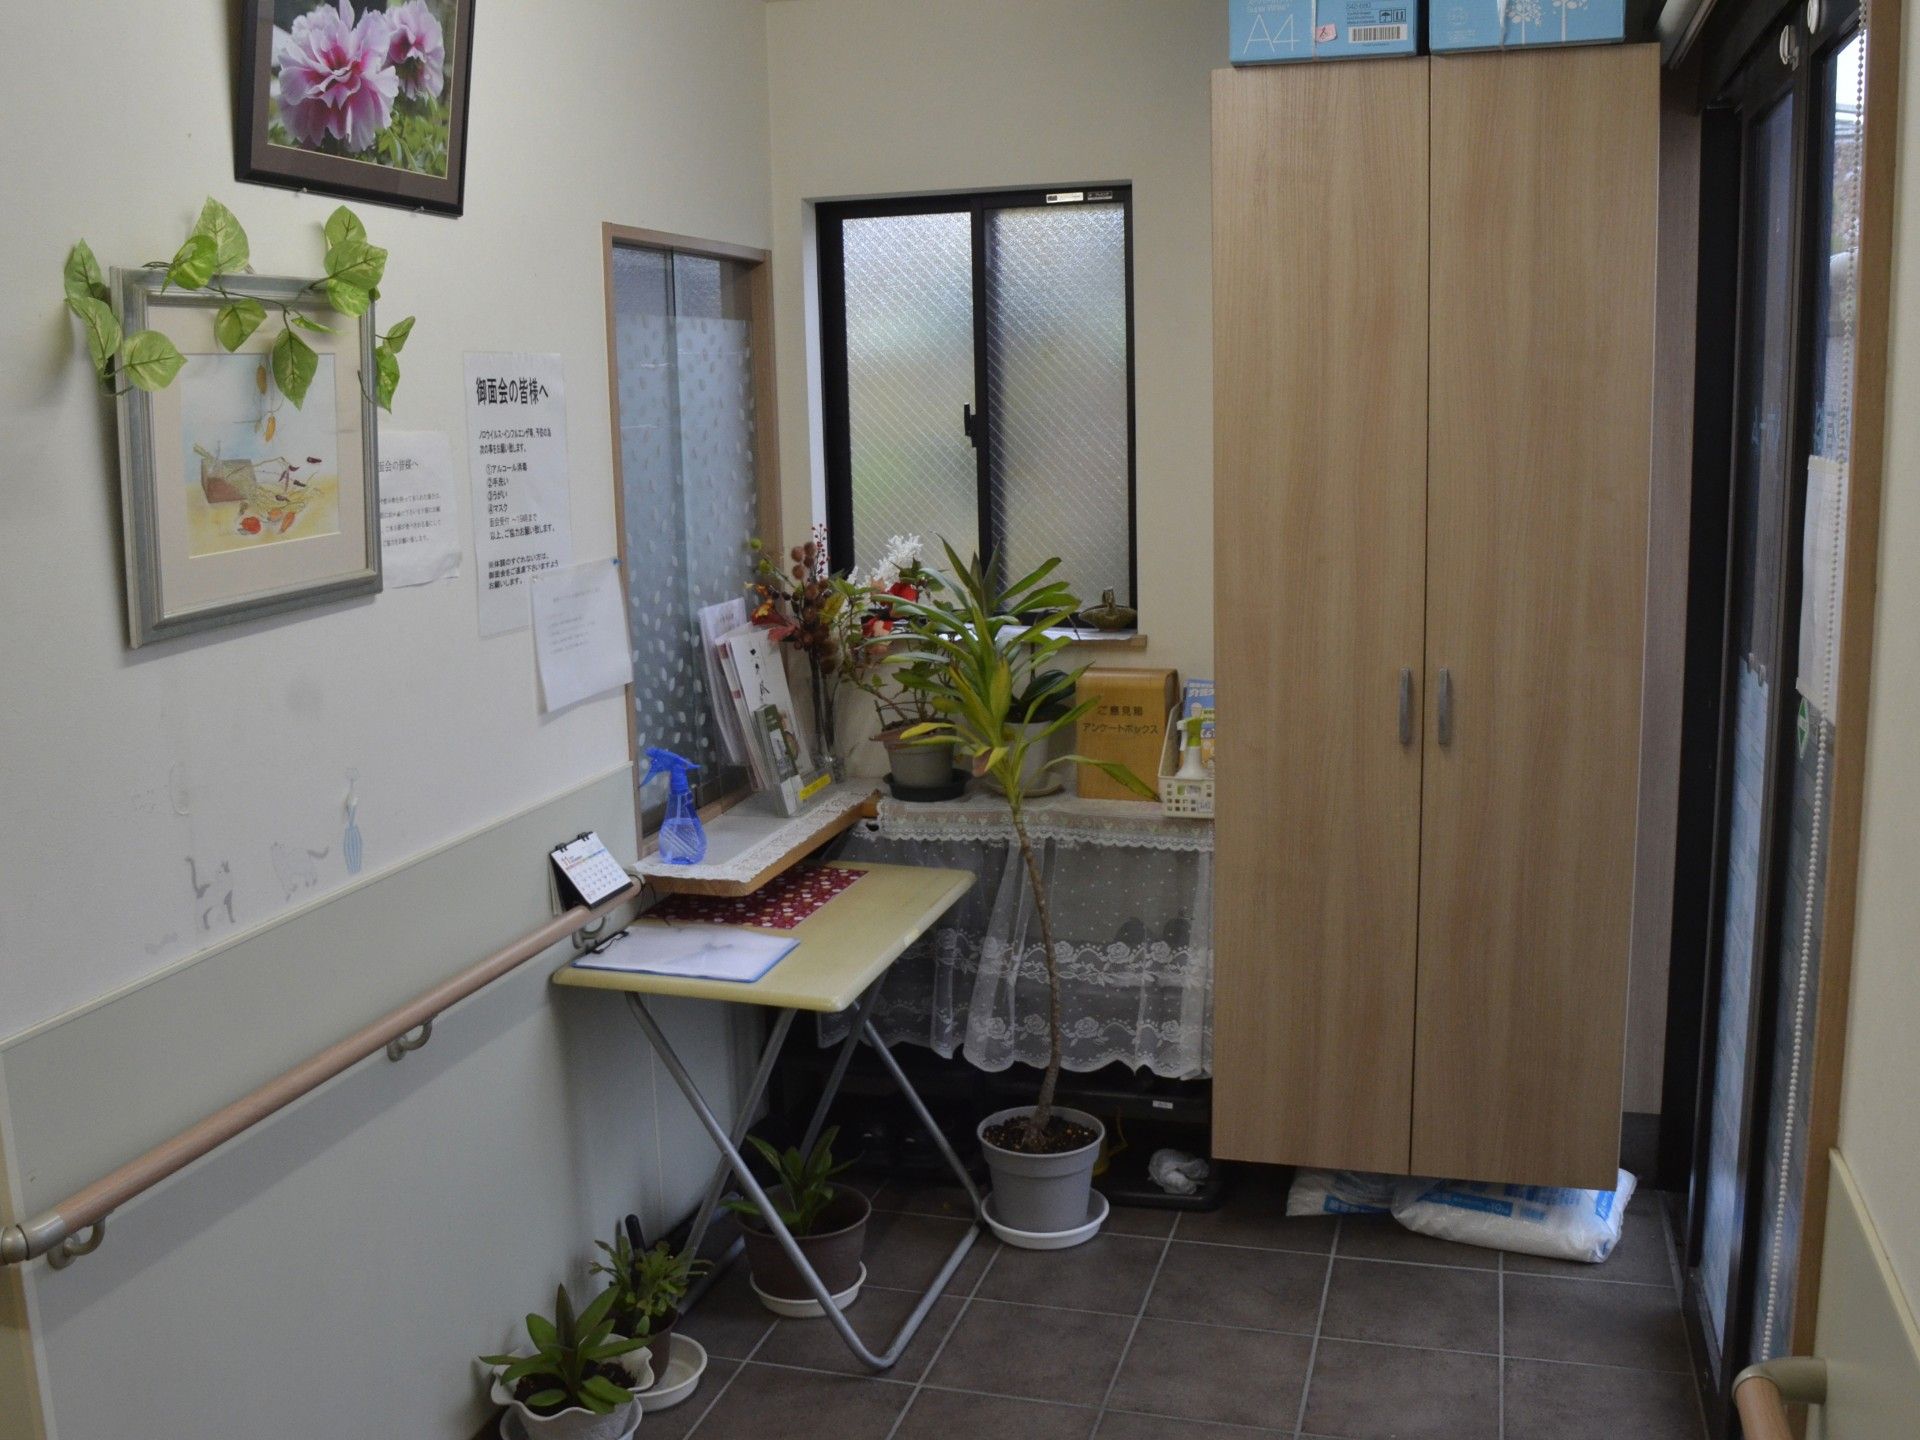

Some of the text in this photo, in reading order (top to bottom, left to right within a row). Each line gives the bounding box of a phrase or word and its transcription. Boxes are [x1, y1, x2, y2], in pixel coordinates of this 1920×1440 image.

[1243, 14, 1299, 54] A4
[475, 377, 549, 407] 御面会の皆様へ
[1097, 704, 1144, 717] ご意見箱
